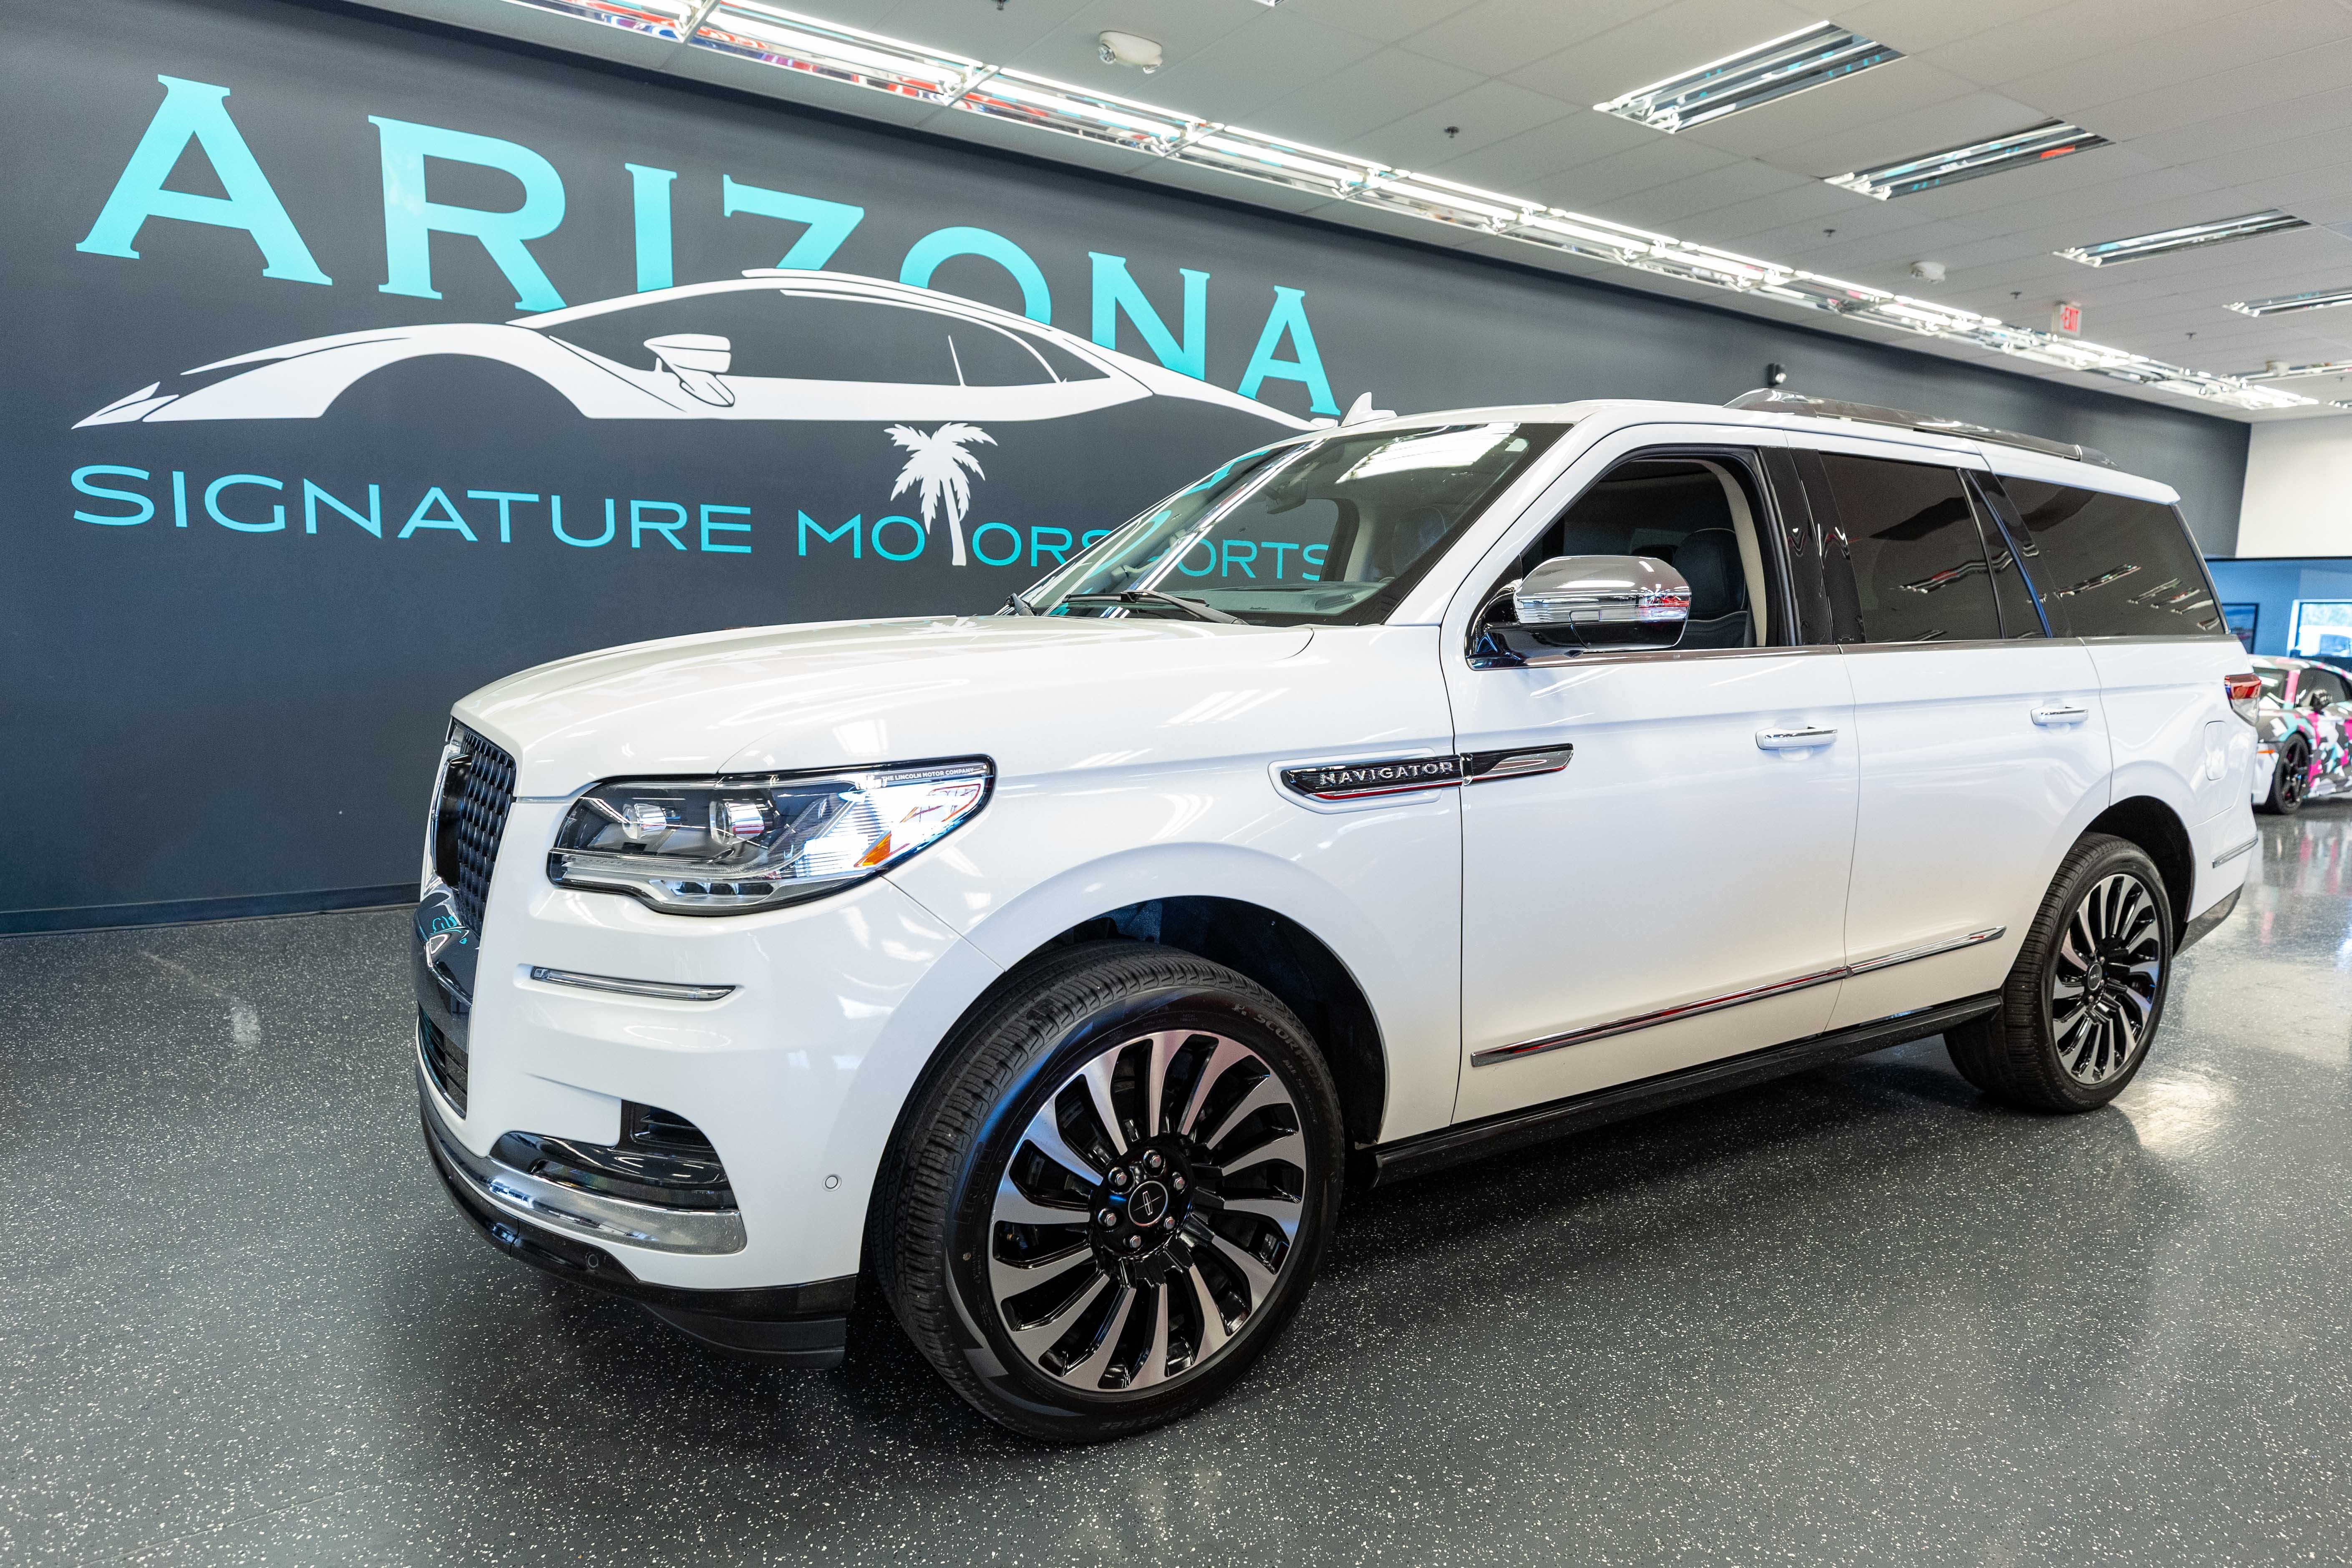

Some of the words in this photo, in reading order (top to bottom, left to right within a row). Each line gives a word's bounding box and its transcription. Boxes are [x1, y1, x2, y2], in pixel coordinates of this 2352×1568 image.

[76, 74, 1341, 416] ARIZONA
[2063, 307, 2079, 332] EXIT
[71, 464, 751, 554] SIGNATURE
[1319, 761, 1454, 786] NAVIGATOR
[1253, 1013, 1325, 1090] SCORPION
